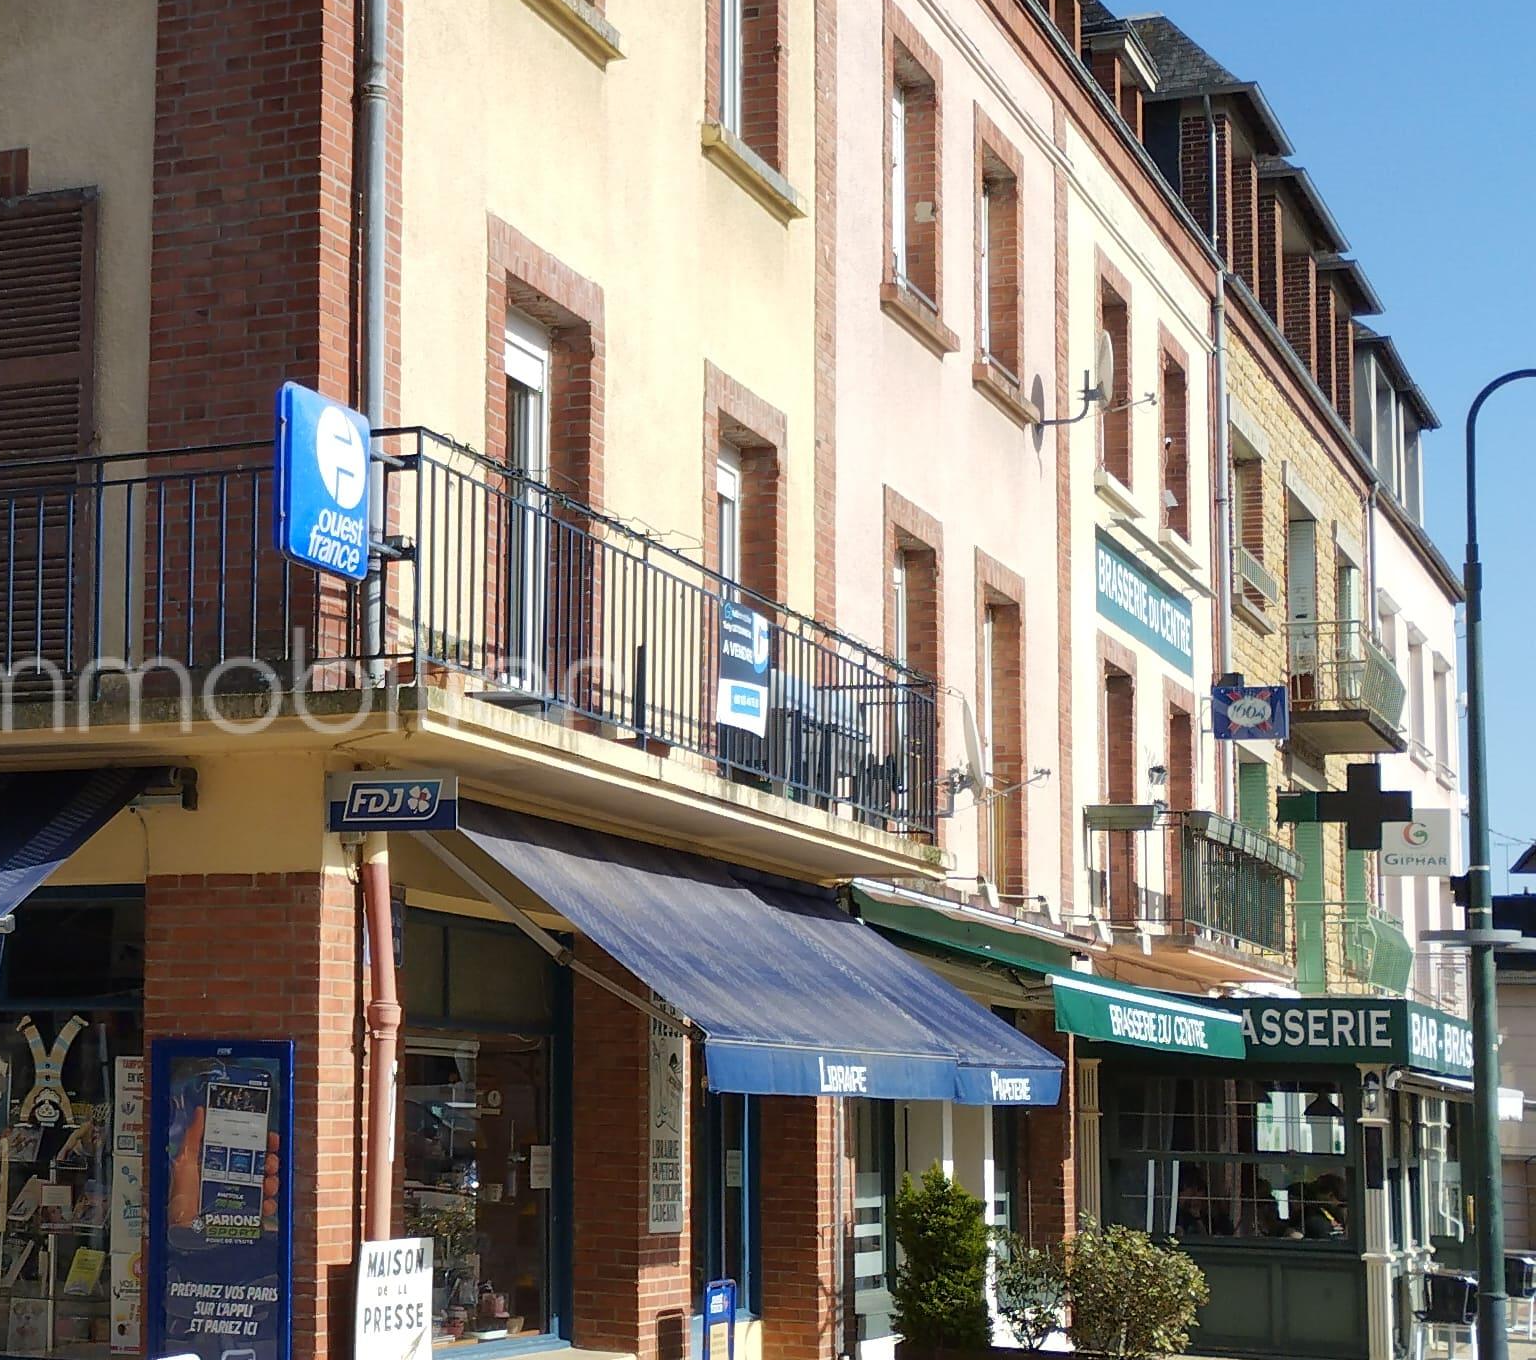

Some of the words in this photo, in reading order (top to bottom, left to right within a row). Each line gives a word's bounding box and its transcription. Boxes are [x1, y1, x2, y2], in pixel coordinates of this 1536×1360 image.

[318, 508, 363, 548] ouest
[307, 524, 360, 573] france
[1098, 548, 1149, 626] BRASSERIE
[1148, 597, 1160, 633] DU
[1161, 597, 1193, 658] CENTRE
[352, 788, 405, 813] FDJ
[1384, 853, 1448, 866] GIPHAR
[1108, 1004, 1157, 1040] BRASSERIE
[1173, 1021, 1209, 1049] CENTRE
[1241, 1008, 1392, 1048] ASSERIE
[1411, 1014, 1438, 1061] BAR
[205, 1214, 261, 1227] PARIONS
[208, 1227, 257, 1237] SPORT
[367, 1248, 424, 1278] MAISON
[170, 1281, 223, 1299] PRÉPAREZ
[225, 1285, 246, 1300] VOS
[247, 1286, 279, 1302] PARIS
[194, 1301, 215, 1316] SUR
[216, 1302, 254, 1318] L'APPLI
[365, 1303, 424, 1334] PRESSE
[189, 1318, 204, 1333] ET
[204, 1319, 242, 1335] PARIEZ
[243, 1321, 259, 1336] ICI
